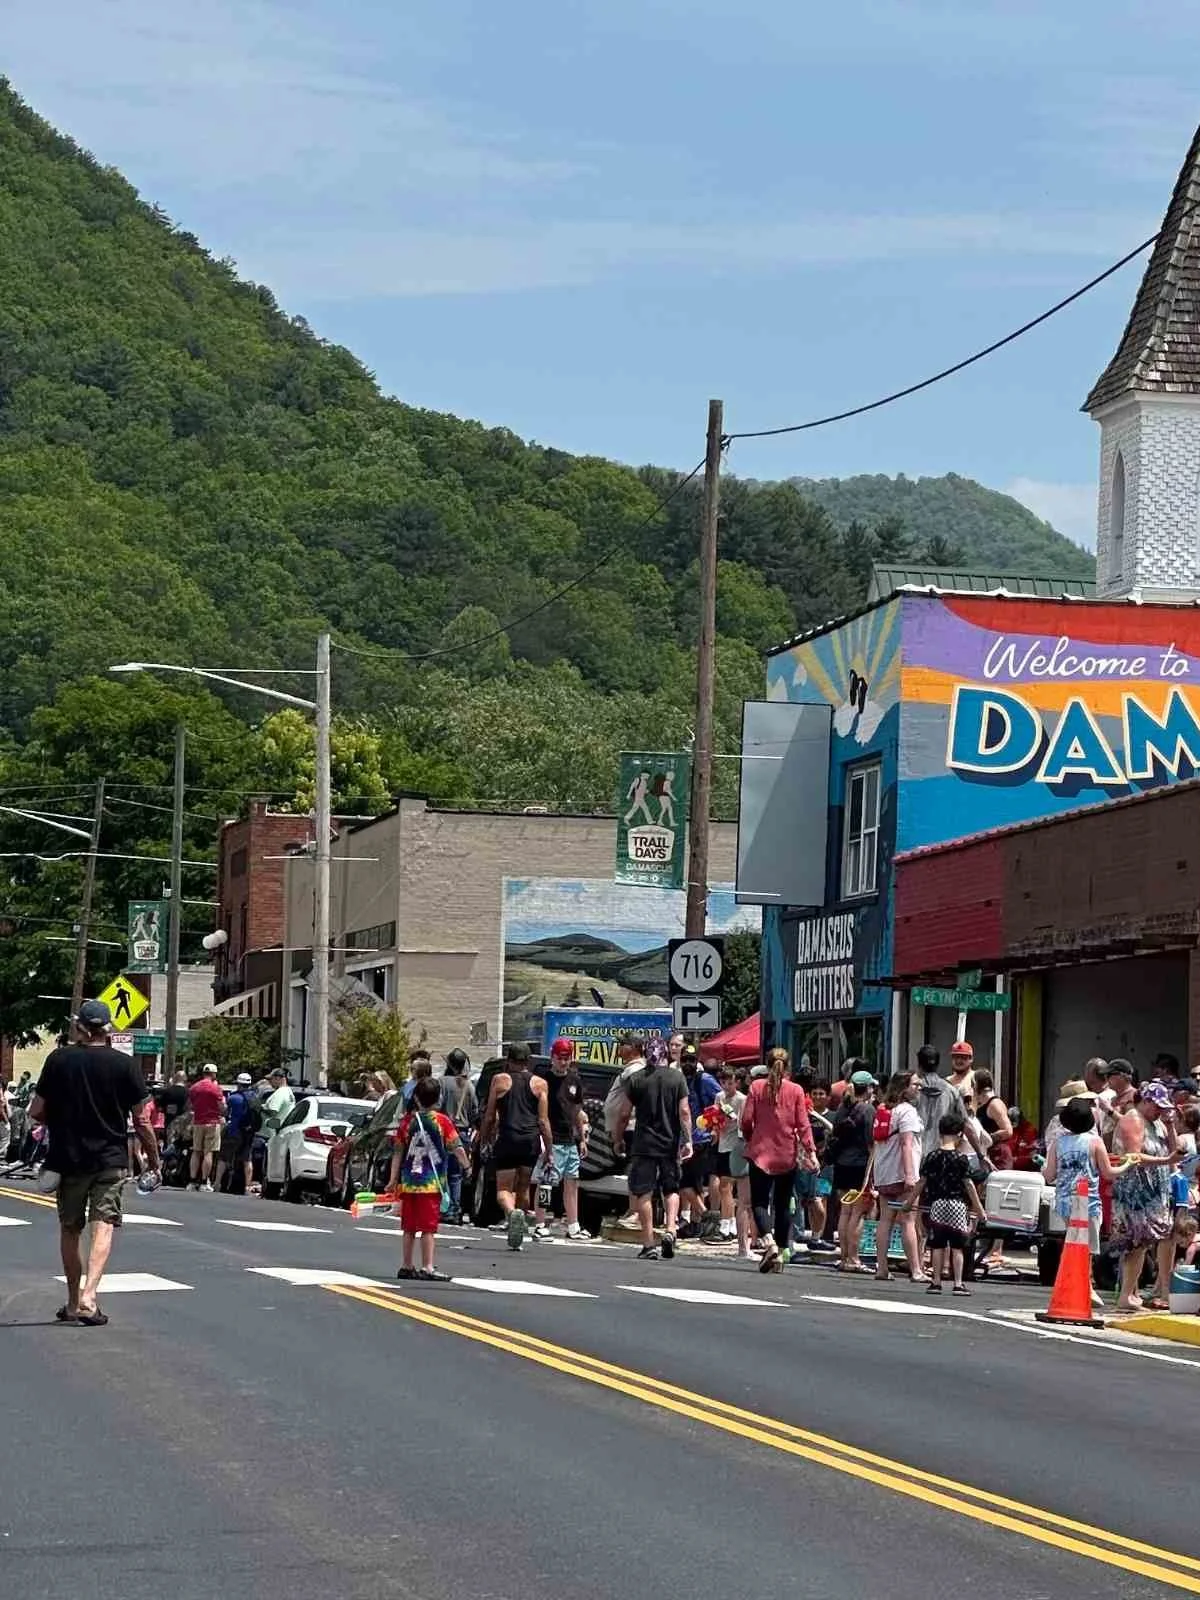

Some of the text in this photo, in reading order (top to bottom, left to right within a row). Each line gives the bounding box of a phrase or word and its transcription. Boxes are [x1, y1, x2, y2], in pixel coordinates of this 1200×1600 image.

[983, 636, 1191, 678] Welcome to
[632, 836, 670, 848] TRAIL
[635, 847, 667, 859] DAYS
[797, 913, 854, 964] DAMASCUS
[680, 954, 713, 979] 716
[795, 964, 854, 1013] OUTFITTERS
[112, 1034, 132, 1043] STOP
[560, 1026, 583, 1036] ARE
[585, 1026, 608, 1036] YOU
